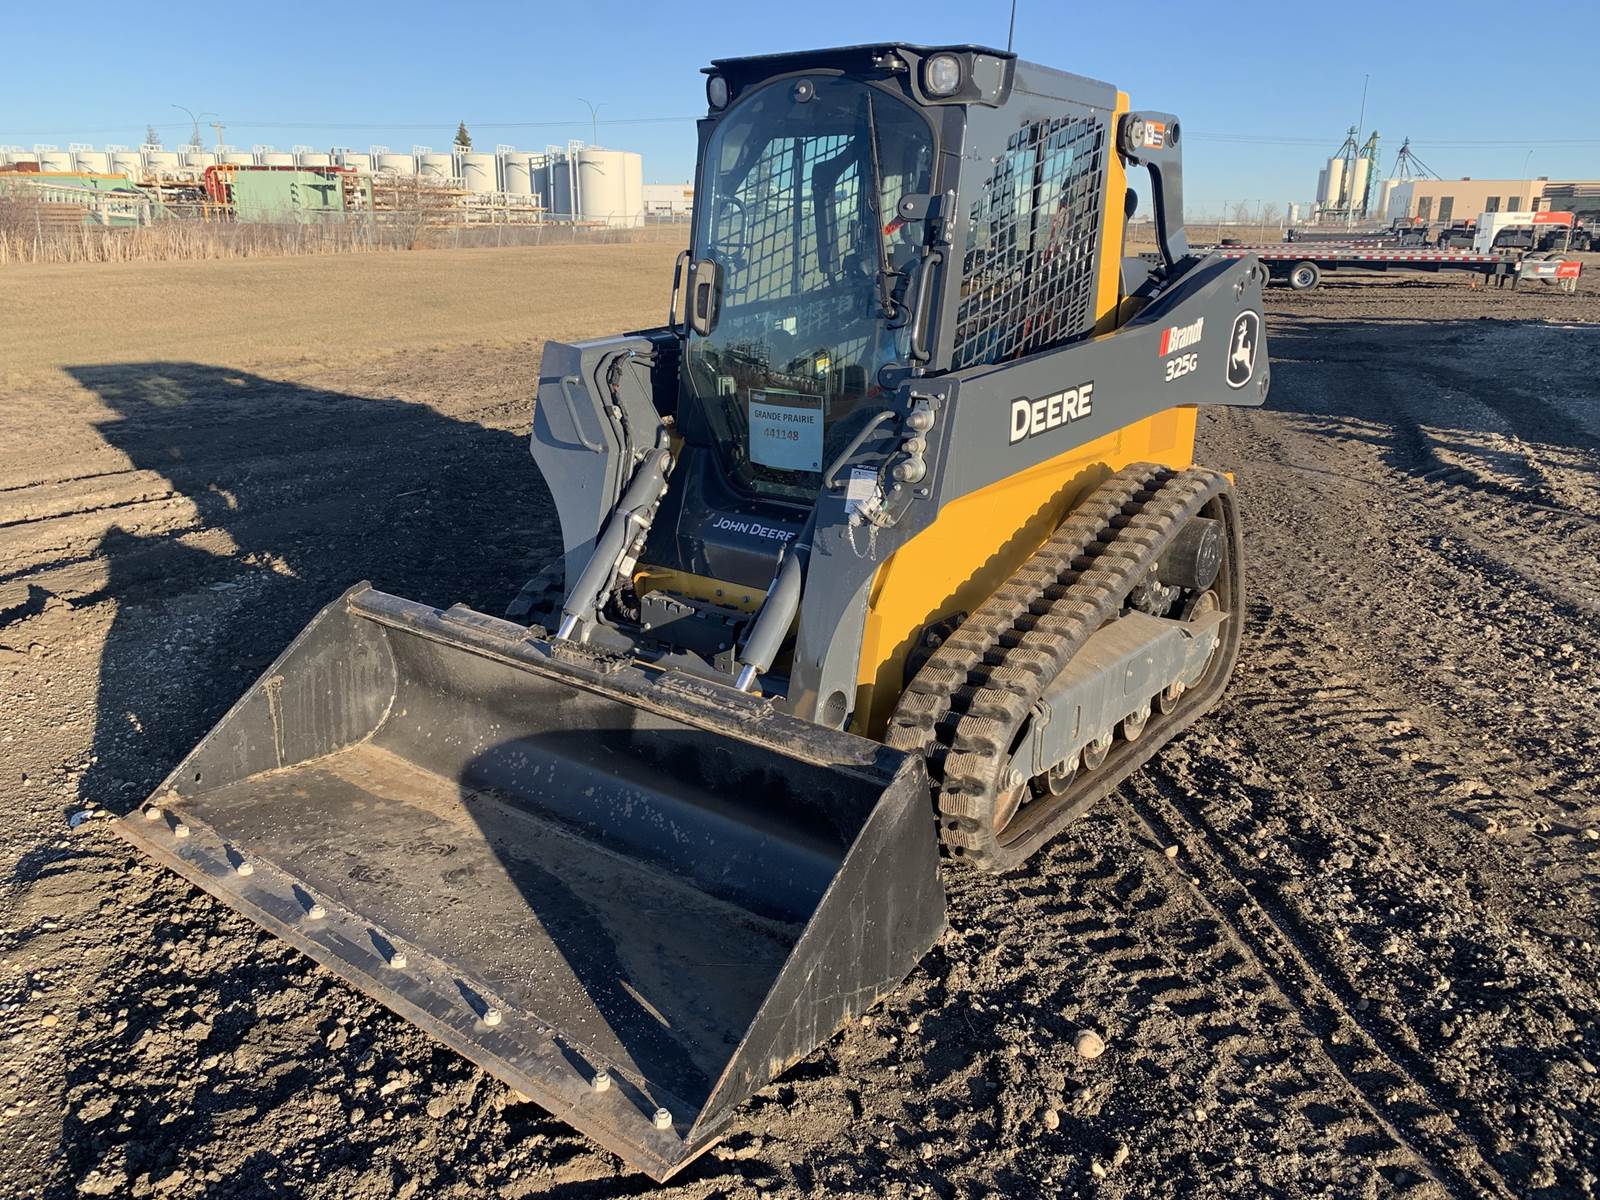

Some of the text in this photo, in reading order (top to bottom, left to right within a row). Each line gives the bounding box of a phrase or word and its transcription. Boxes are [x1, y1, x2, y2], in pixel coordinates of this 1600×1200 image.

[1167, 316, 1204, 354] Brandt
[1165, 353, 1198, 382] 325G
[754, 409, 815, 424] GRANDE PRAIRIE
[1009, 382, 1094, 443] DEERE
[763, 427, 800, 441] 441148
[712, 516, 796, 542] JOHN DEERE
